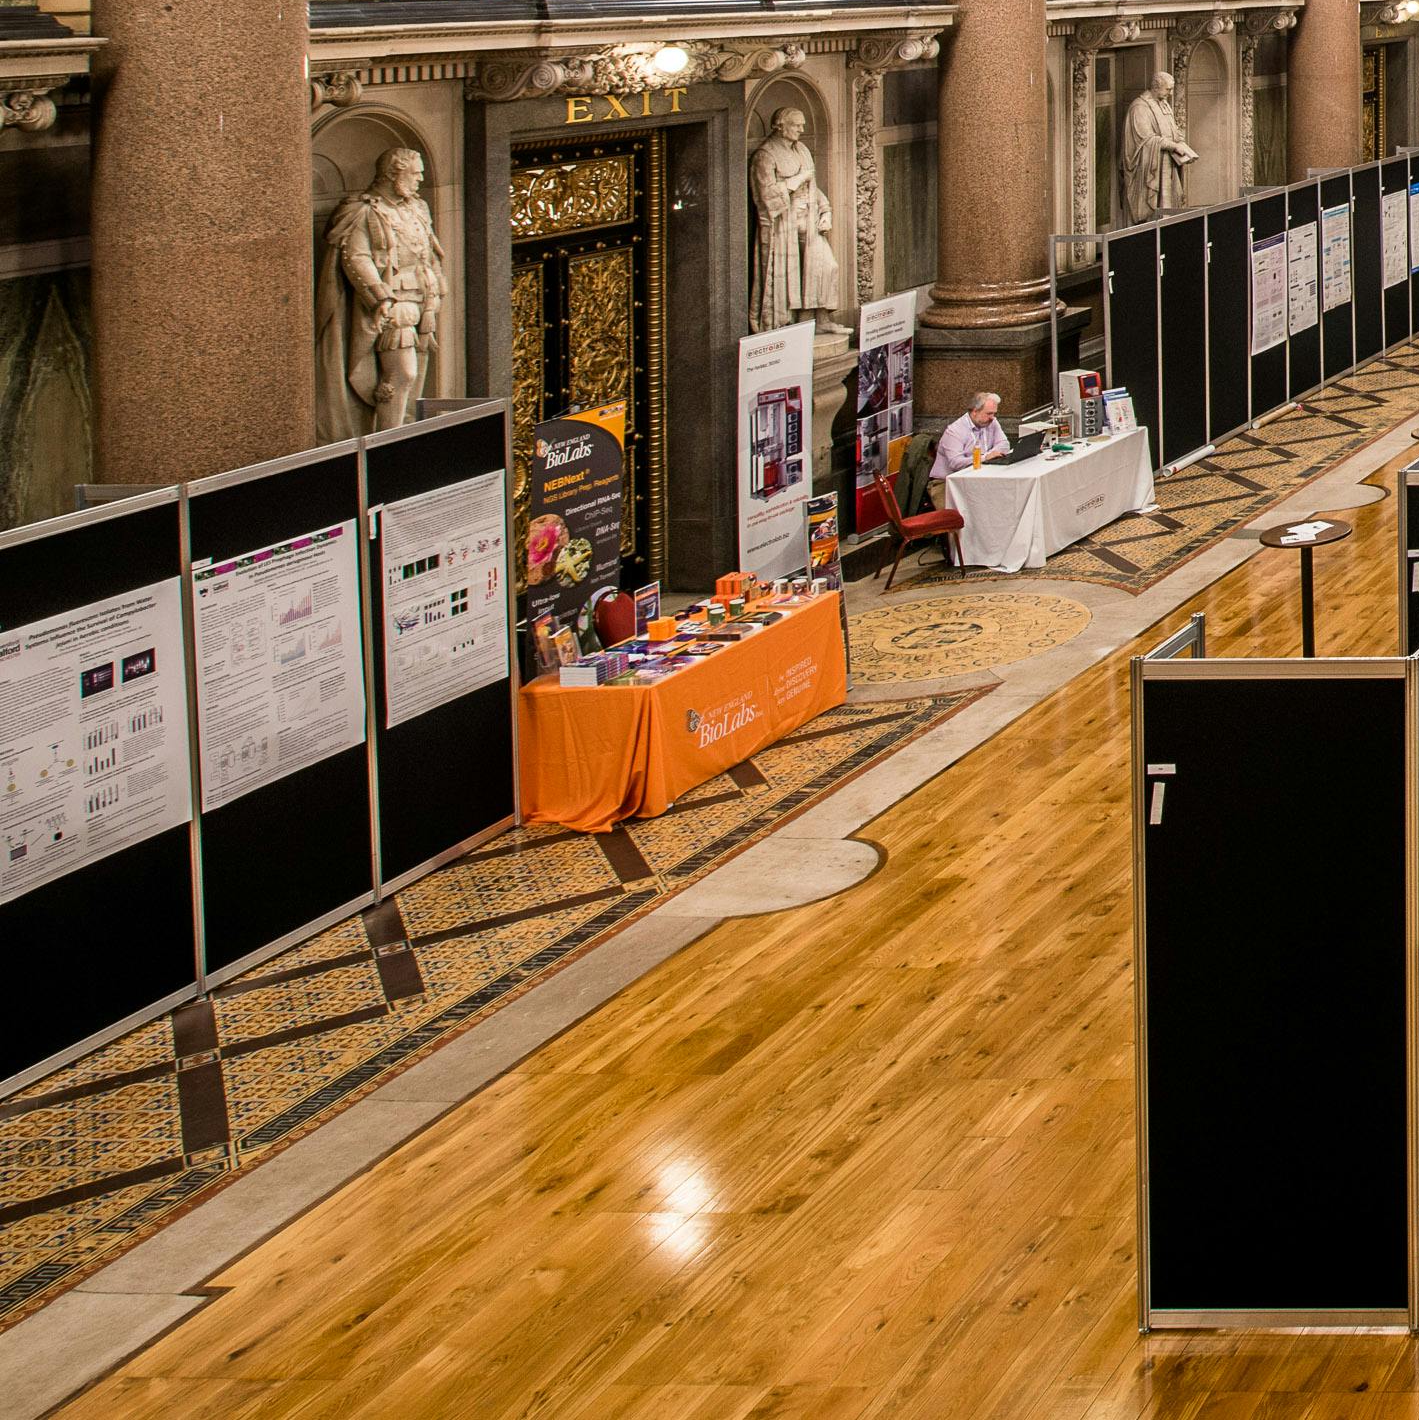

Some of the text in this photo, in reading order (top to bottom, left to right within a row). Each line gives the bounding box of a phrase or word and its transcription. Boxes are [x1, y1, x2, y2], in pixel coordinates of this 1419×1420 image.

[565, 87, 687, 124] EXIT
[748, 342, 785, 357] electrolab
[566, 434, 591, 446] ENGLAND
[544, 441, 593, 470] BioLabs
[565, 500, 597, 516] Directional
[0, 644, 21, 657] alford
[786, 656, 812, 677] INSPIRED
[786, 664, 818, 688] DISCOVERY
[786, 681, 811, 700] GENUINE
[724, 691, 753, 712] ENGLAND
[698, 703, 756, 749] BioLabs
